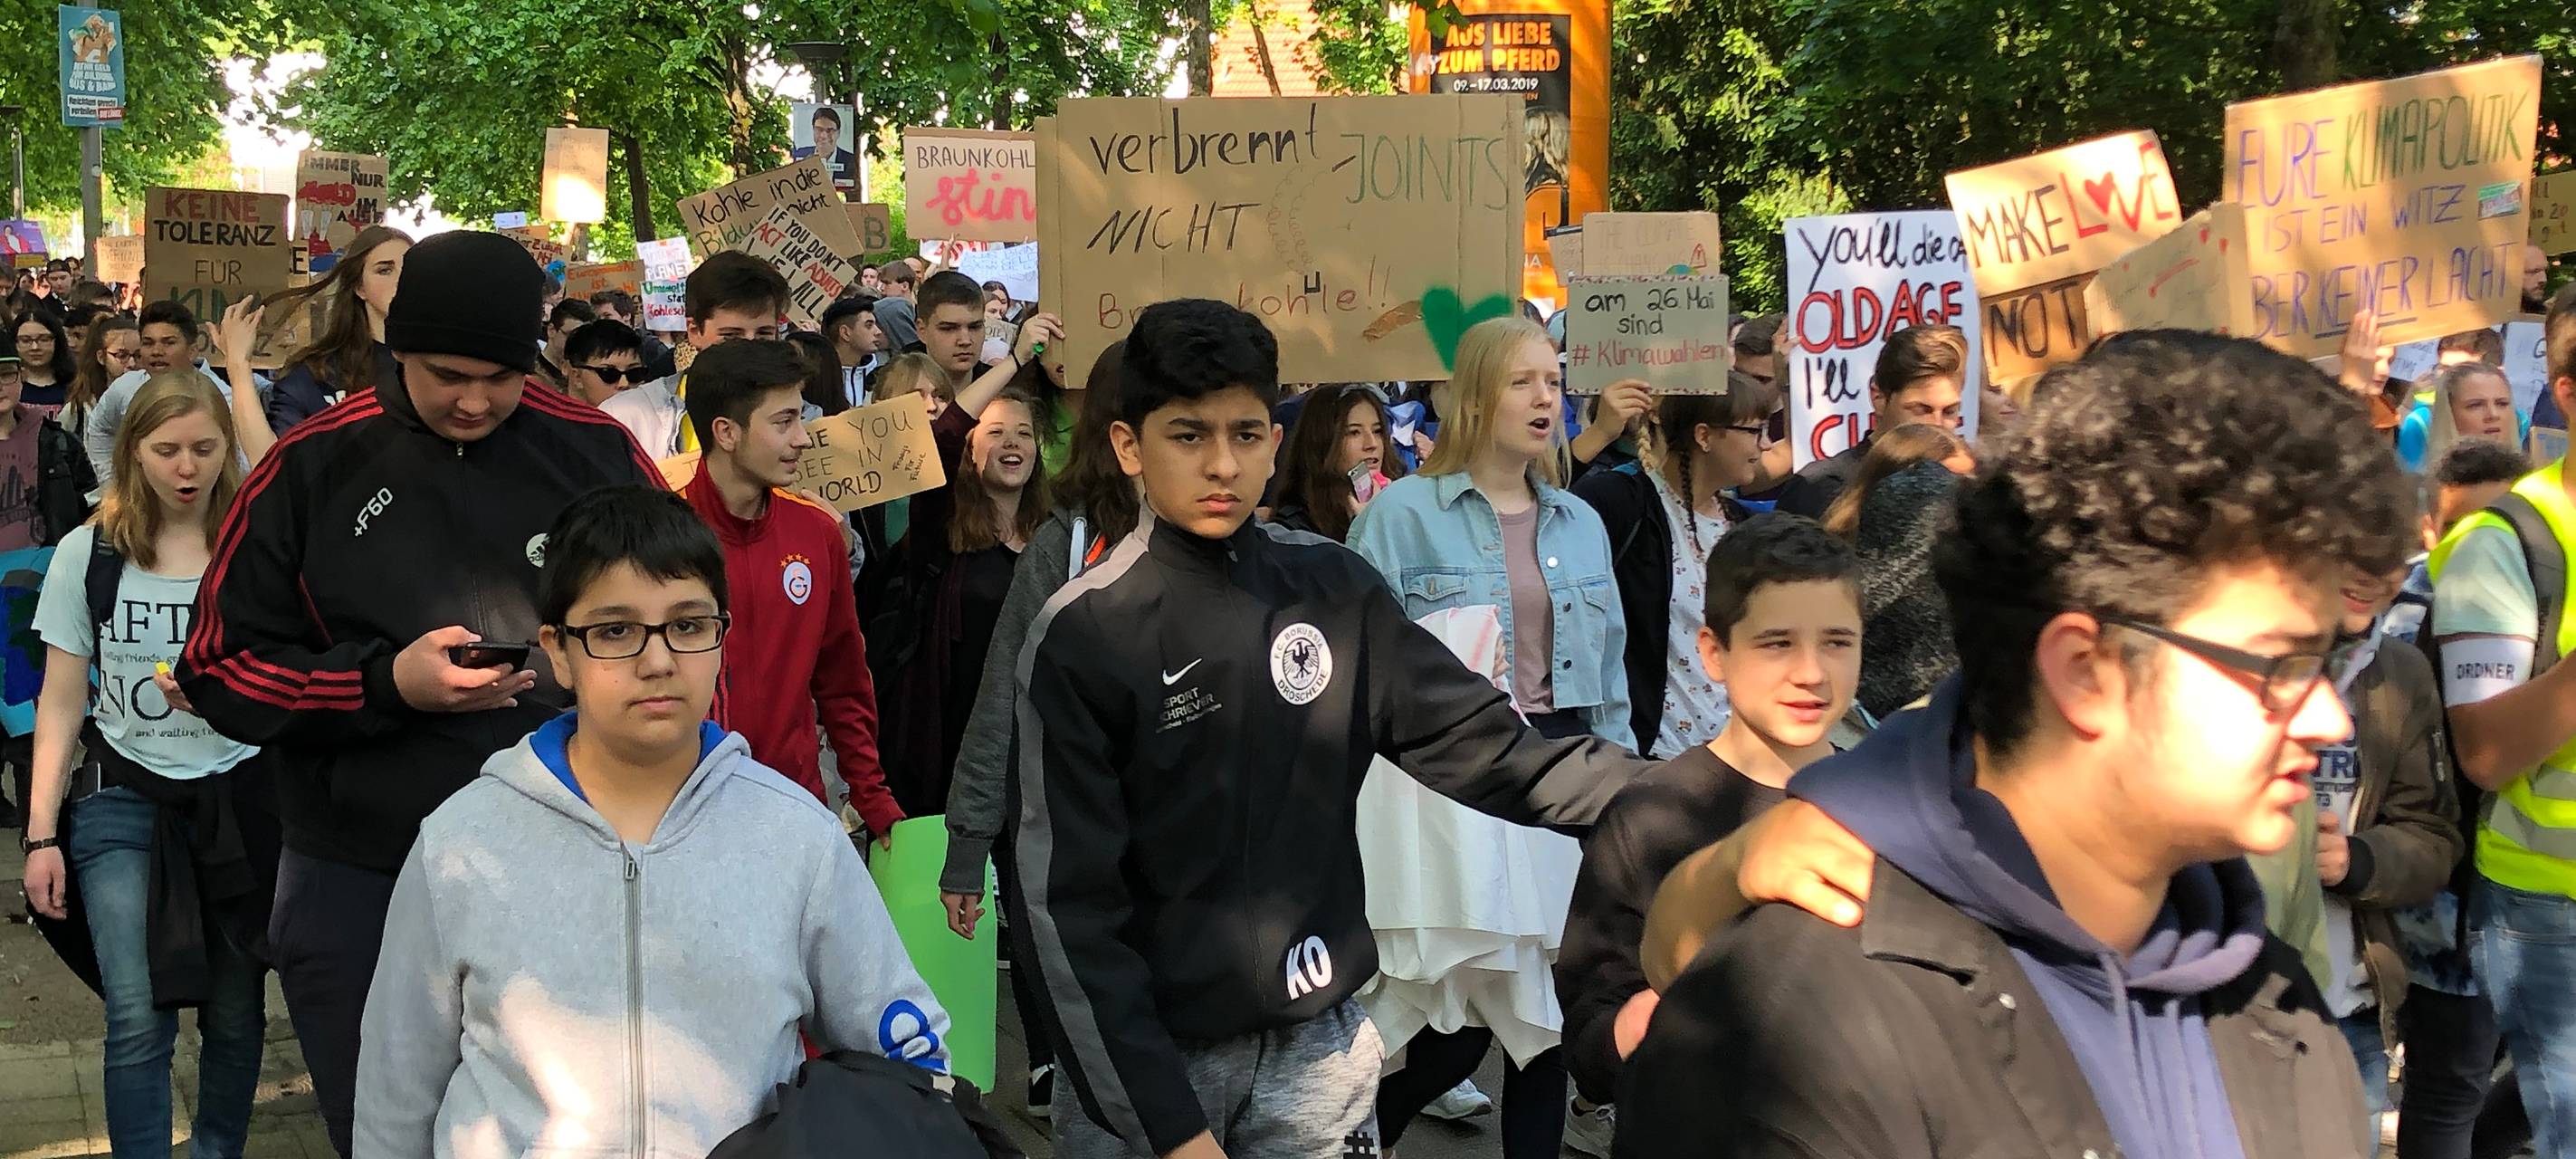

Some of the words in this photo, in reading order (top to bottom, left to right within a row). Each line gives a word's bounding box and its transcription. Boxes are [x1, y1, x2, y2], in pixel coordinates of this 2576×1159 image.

[1445, 21, 1486, 48] AUS
[1492, 21, 1552, 46] LIEBE
[1436, 48, 1485, 74] ZUM
[1491, 47, 1561, 73] PFERD
[1453, 77, 1540, 92] 09.-17.03.2019
[916, 145, 1036, 169] BRAUNKOHL
[1089, 102, 1320, 175] verbrennt
[1340, 132, 1510, 211] JOINTS
[2237, 119, 2336, 210] EURE
[2342, 91, 2528, 192] KLIMAPOLITIK
[350, 172, 385, 188] NUR
[925, 167, 1036, 226] stin
[165, 190, 261, 223] KEINE
[692, 187, 760, 227] Kohle
[794, 168, 822, 191] die
[153, 219, 276, 247] TOLERANZ
[768, 206, 788, 225] IF
[785, 218, 811, 244] YOU
[1086, 200, 1263, 255] NICHT
[1966, 184, 2070, 268] MAKE
[2264, 209, 2311, 254] IST
[2319, 203, 2368, 244] EIN
[2392, 184, 2467, 231] WITZ
[754, 222, 786, 248] ACT
[779, 240, 812, 269] LIKE
[195, 259, 243, 285] FÜR
[666, 293, 685, 303] stat
[1584, 292, 1626, 312] am
[1686, 285, 1715, 311] Mai
[2250, 270, 2310, 340] BER
[2425, 242, 2520, 310] LACHT
[1616, 313, 1664, 336] sind
[1796, 288, 1883, 354] OLD
[1883, 278, 1963, 342] AGE
[1989, 279, 2081, 366] NOT
[847, 410, 913, 445] YOU
[857, 443, 883, 468] IN
[2456, 662, 2515, 681] ORDNER
[1163, 687, 1199, 709] SPORT
[1286, 934, 1335, 1001] KO
